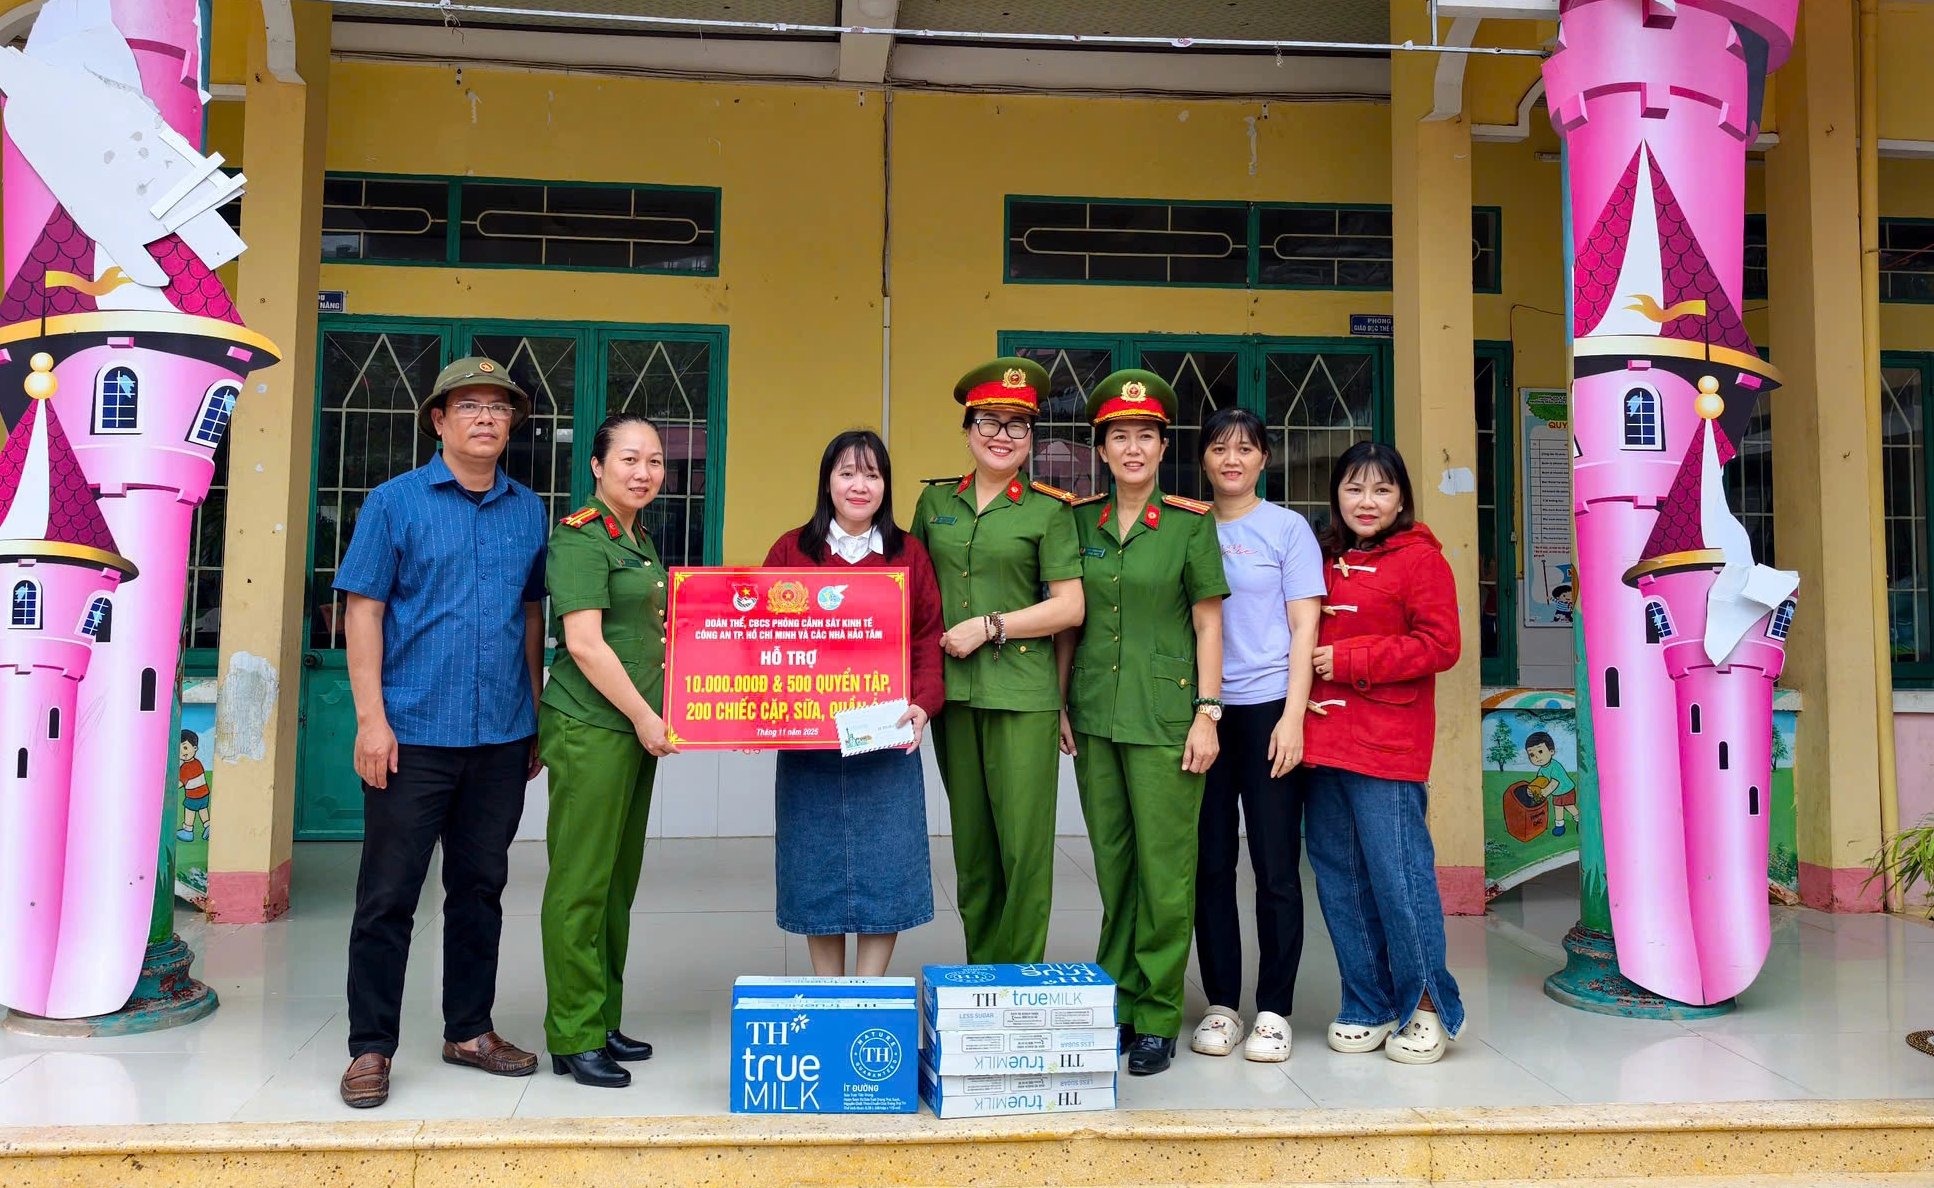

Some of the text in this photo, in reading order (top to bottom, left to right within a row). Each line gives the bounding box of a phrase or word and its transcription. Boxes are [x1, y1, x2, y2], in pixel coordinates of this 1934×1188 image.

[749, 618, 770, 628] CBCS
[772, 617, 799, 628] PHÒNG
[801, 616, 824, 628] CẢNH
[825, 617, 840, 628] SÁT
[842, 618, 862, 628] KINH
[863, 616, 873, 628] TẾ
[695, 628, 883, 640] CÔNG AN TP. HỒ CHÍ MINH VÀ CÁC NHÀ HẢO TÂM
[761, 646, 817, 668] HỖ TRỢ
[685, 667, 891, 696] 10.000.000Đ & 500 QUYỂN TẬP,
[686, 701, 712, 721] 200
[716, 696, 756, 721] CHIẾC
[760, 698, 790, 724] CẶP,
[794, 698, 825, 722] SỮA,
[757, 728, 819, 737] Tháng 11 năm 2025
[972, 992, 997, 1007] TH
[746, 1021, 789, 1045] TH
[862, 1047, 890, 1062] TH
[1060, 1053, 1084, 1067] TH
[742, 1047, 820, 1081] true
[843, 1082, 879, 1092] ÍT ĐƯỜNG
[744, 1082, 820, 1110] MILK
[1058, 1092, 1081, 1106] TH
